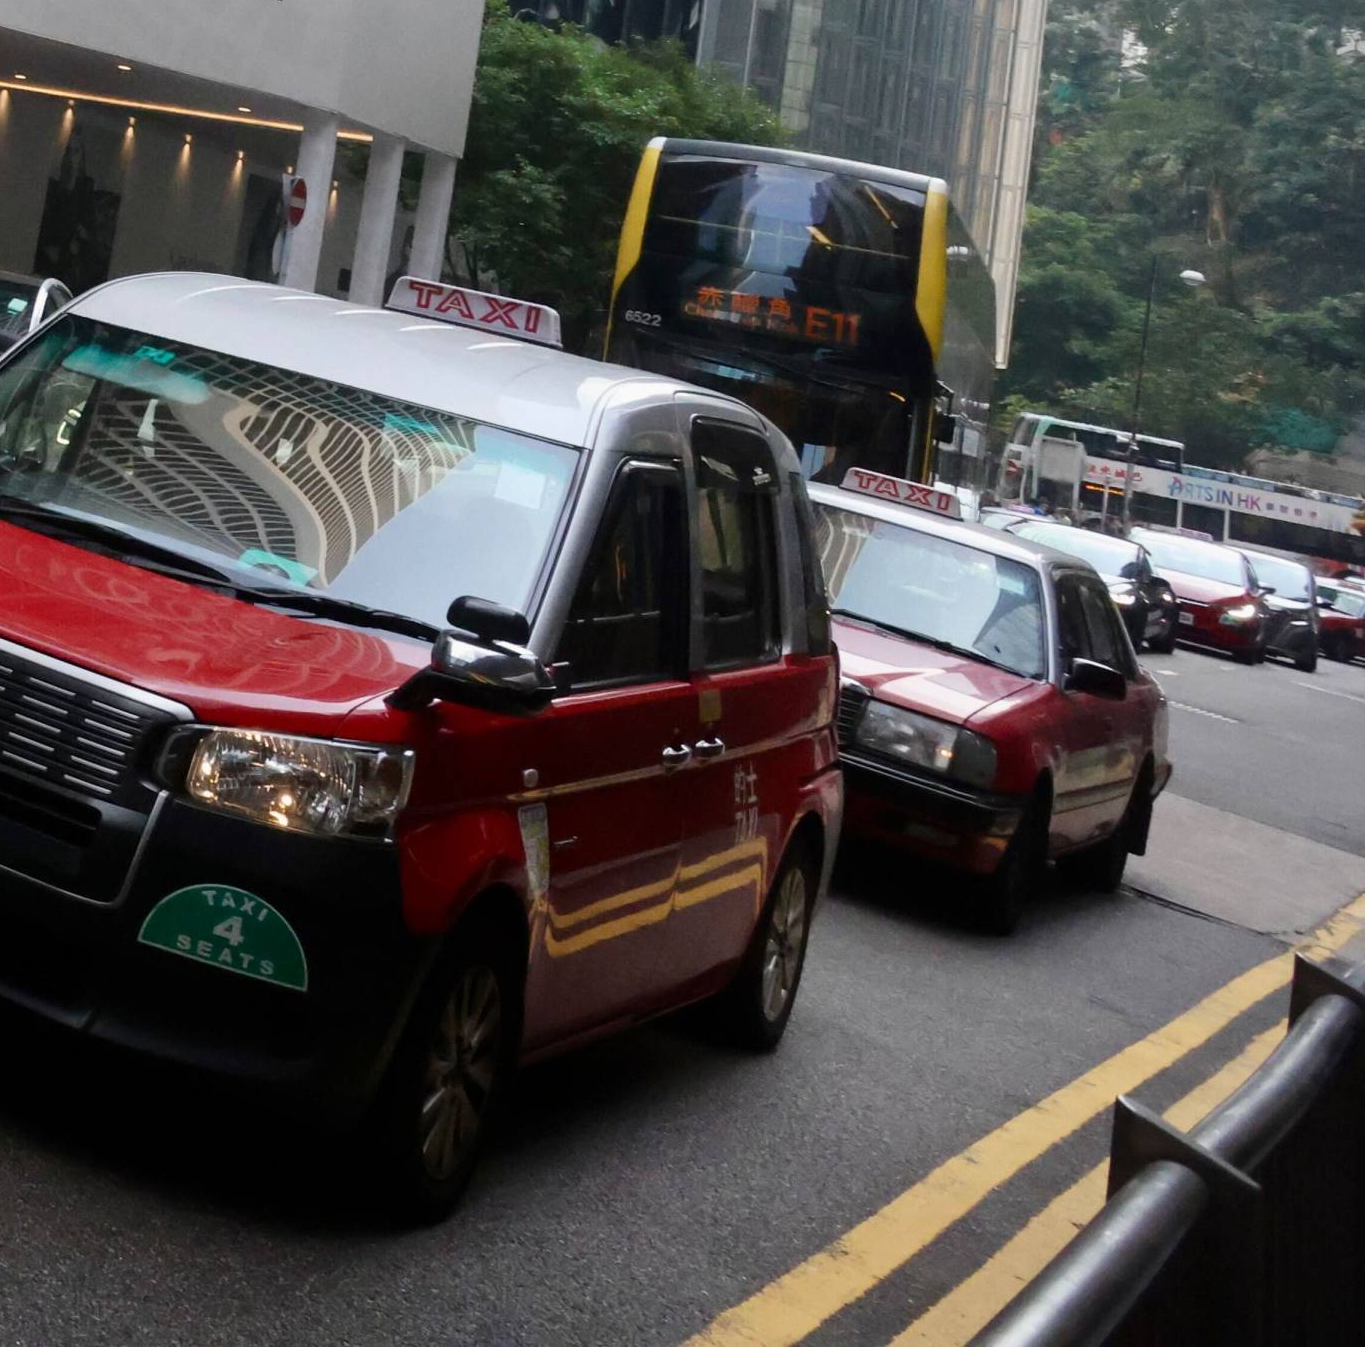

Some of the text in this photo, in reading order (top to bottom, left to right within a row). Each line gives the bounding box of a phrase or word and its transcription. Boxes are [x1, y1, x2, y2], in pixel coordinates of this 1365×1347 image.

[409, 280, 541, 333] TAXI
[624, 309, 662, 328] 6522
[803, 305, 863, 348] E11
[854, 470, 952, 512] TAXI
[1168, 475, 1215, 504] ARTS
[1216, 490, 1234, 506] IN
[1237, 494, 1262, 512] HK
[201, 890, 269, 922] TAXI
[213, 916, 245, 946] 4
[176, 934, 275, 975] SEATS
